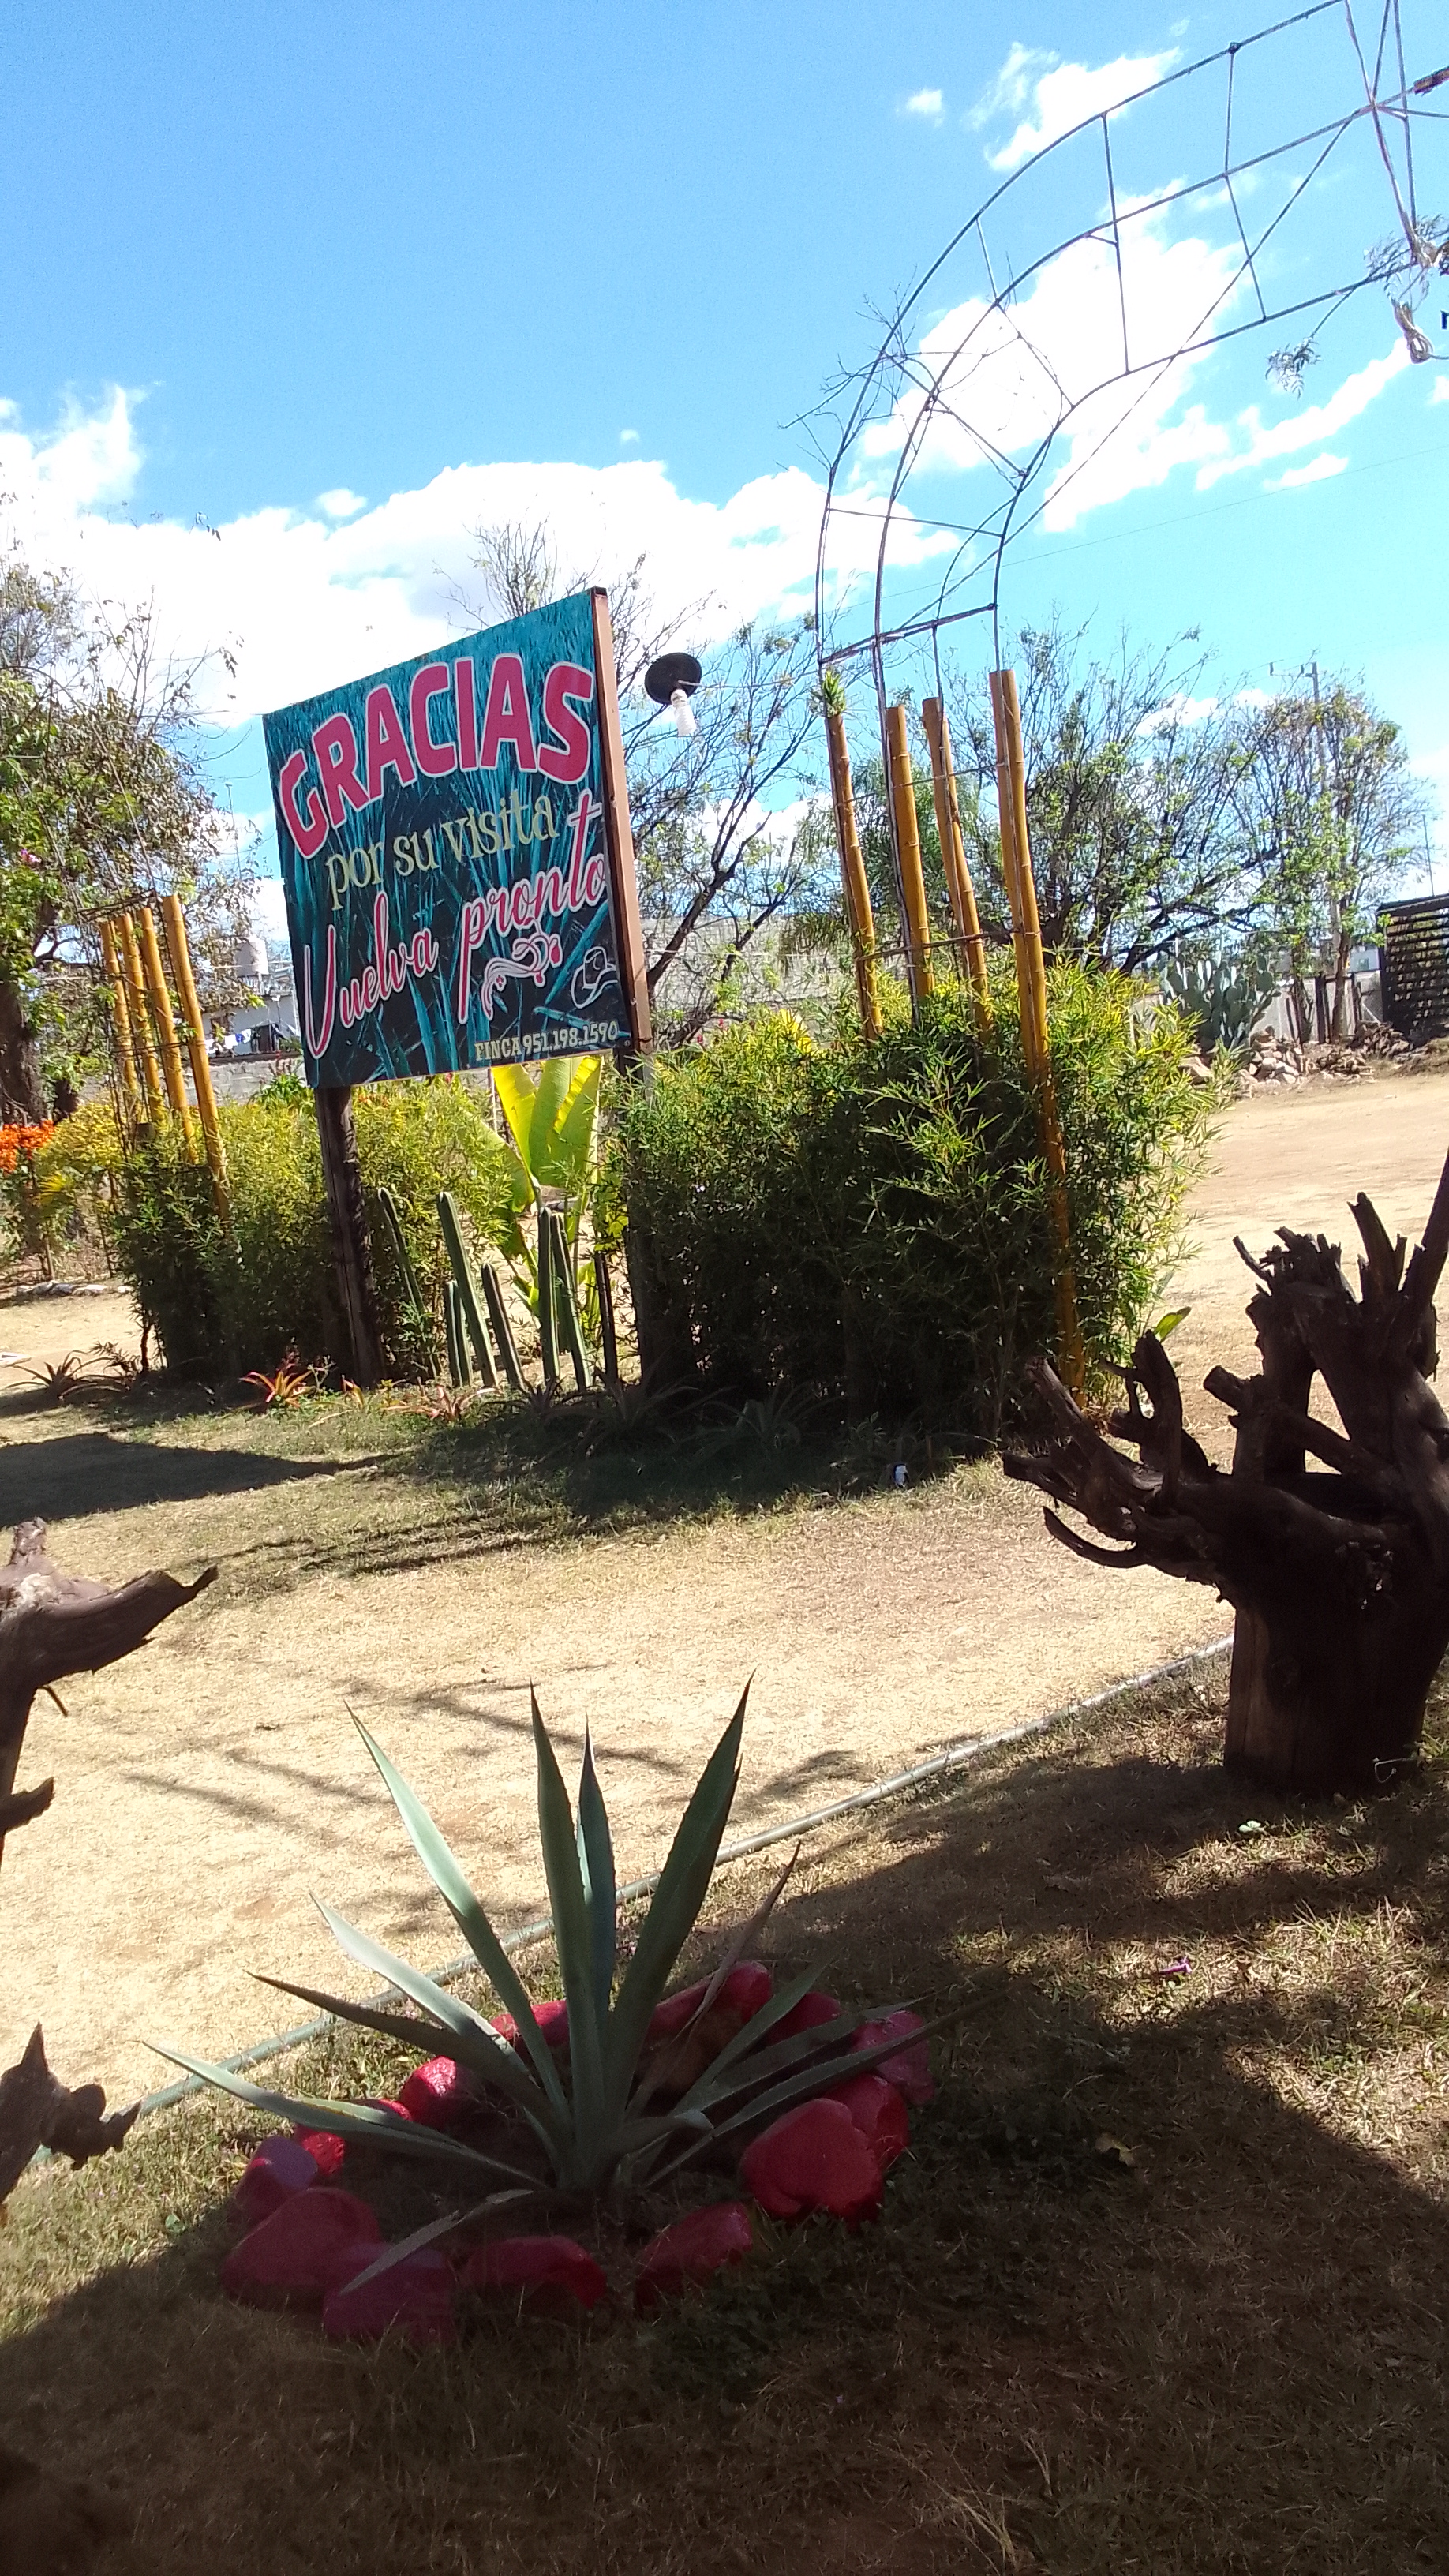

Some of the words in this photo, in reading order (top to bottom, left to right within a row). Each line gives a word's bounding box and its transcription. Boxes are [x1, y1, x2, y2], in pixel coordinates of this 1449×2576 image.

[279, 653, 595, 859] GRACIAS
[305, 891, 439, 1058] Vuelva
[458, 789, 606, 1024] pronto
[325, 841, 384, 911] por
[394, 826, 437, 877] su
[441, 790, 560, 861] visita
[474, 1037, 522, 1061] FINCA
[522, 1020, 619, 1054] 951.198.1590
